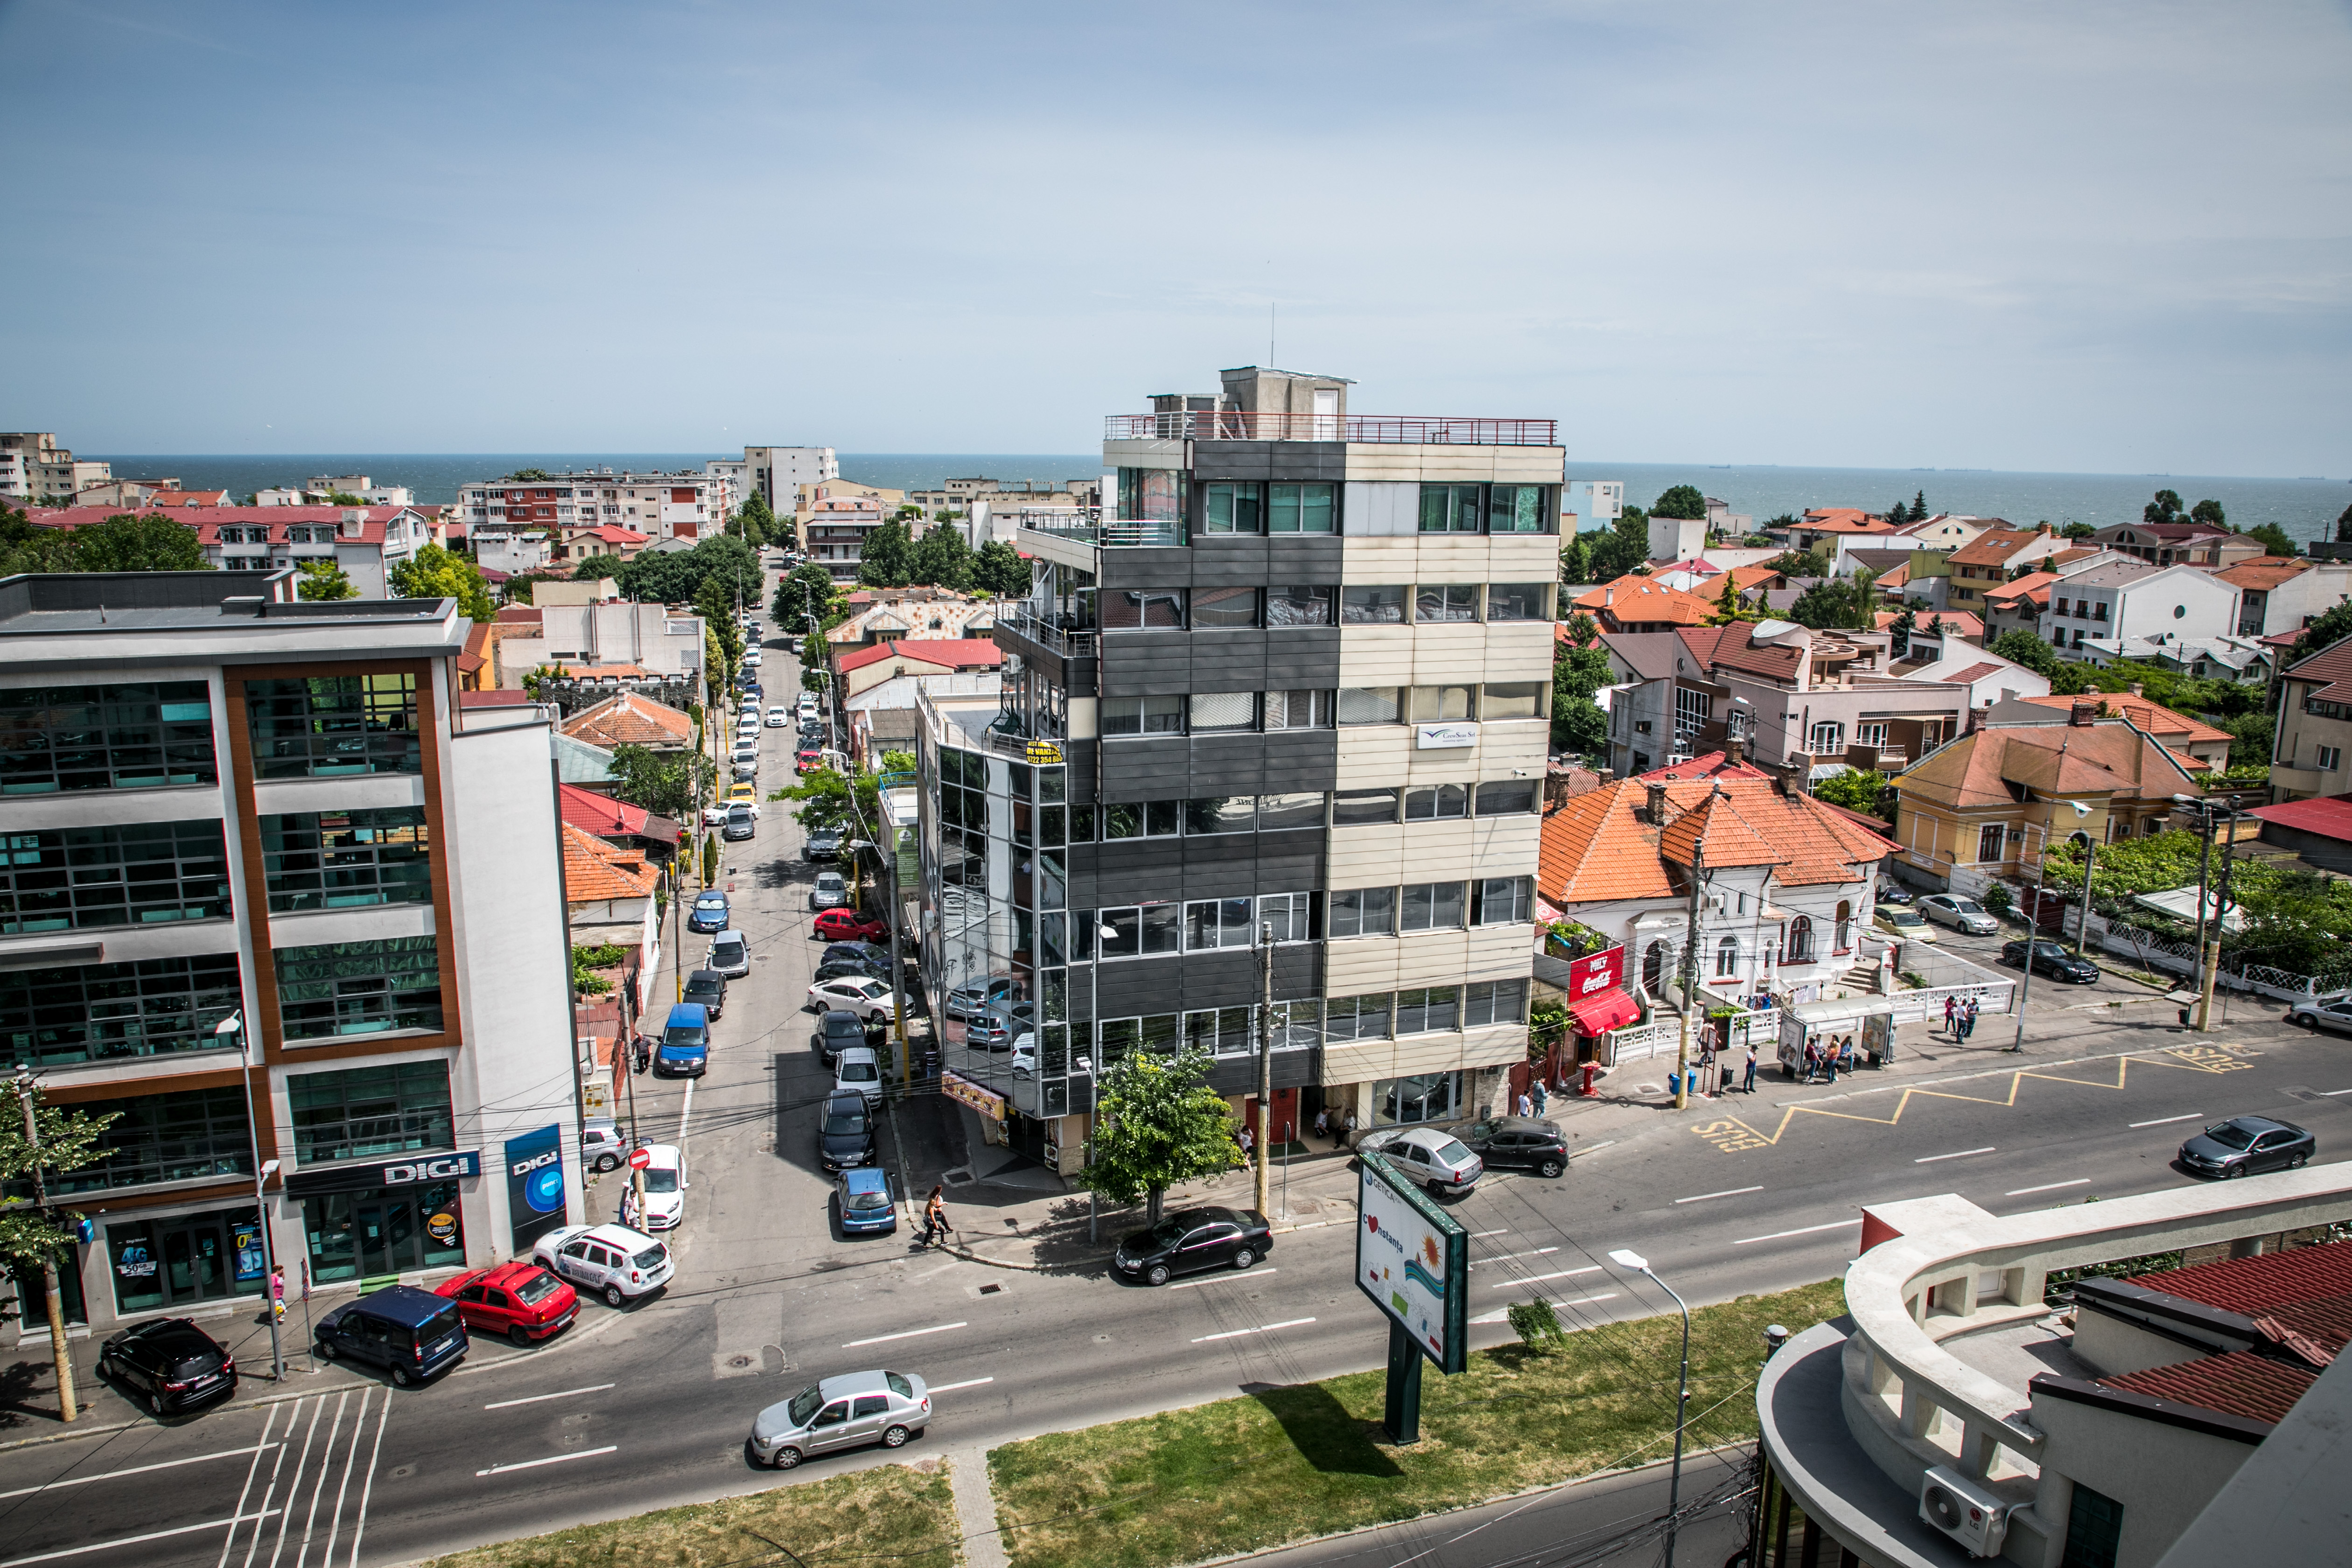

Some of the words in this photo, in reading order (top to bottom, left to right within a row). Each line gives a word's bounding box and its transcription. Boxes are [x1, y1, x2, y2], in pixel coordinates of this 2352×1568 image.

[1590, 956, 1608, 972] MILY
[513, 1151, 558, 1176] DIGI
[384, 1158, 469, 1184] DIGI
[542, 1179, 558, 1190] punct
[1373, 1179, 1394, 1203] GETICA
[237, 1235, 247, 1248] 0
[126, 1264, 139, 1273] 50
[1969, 1520, 1979, 1530] LG
